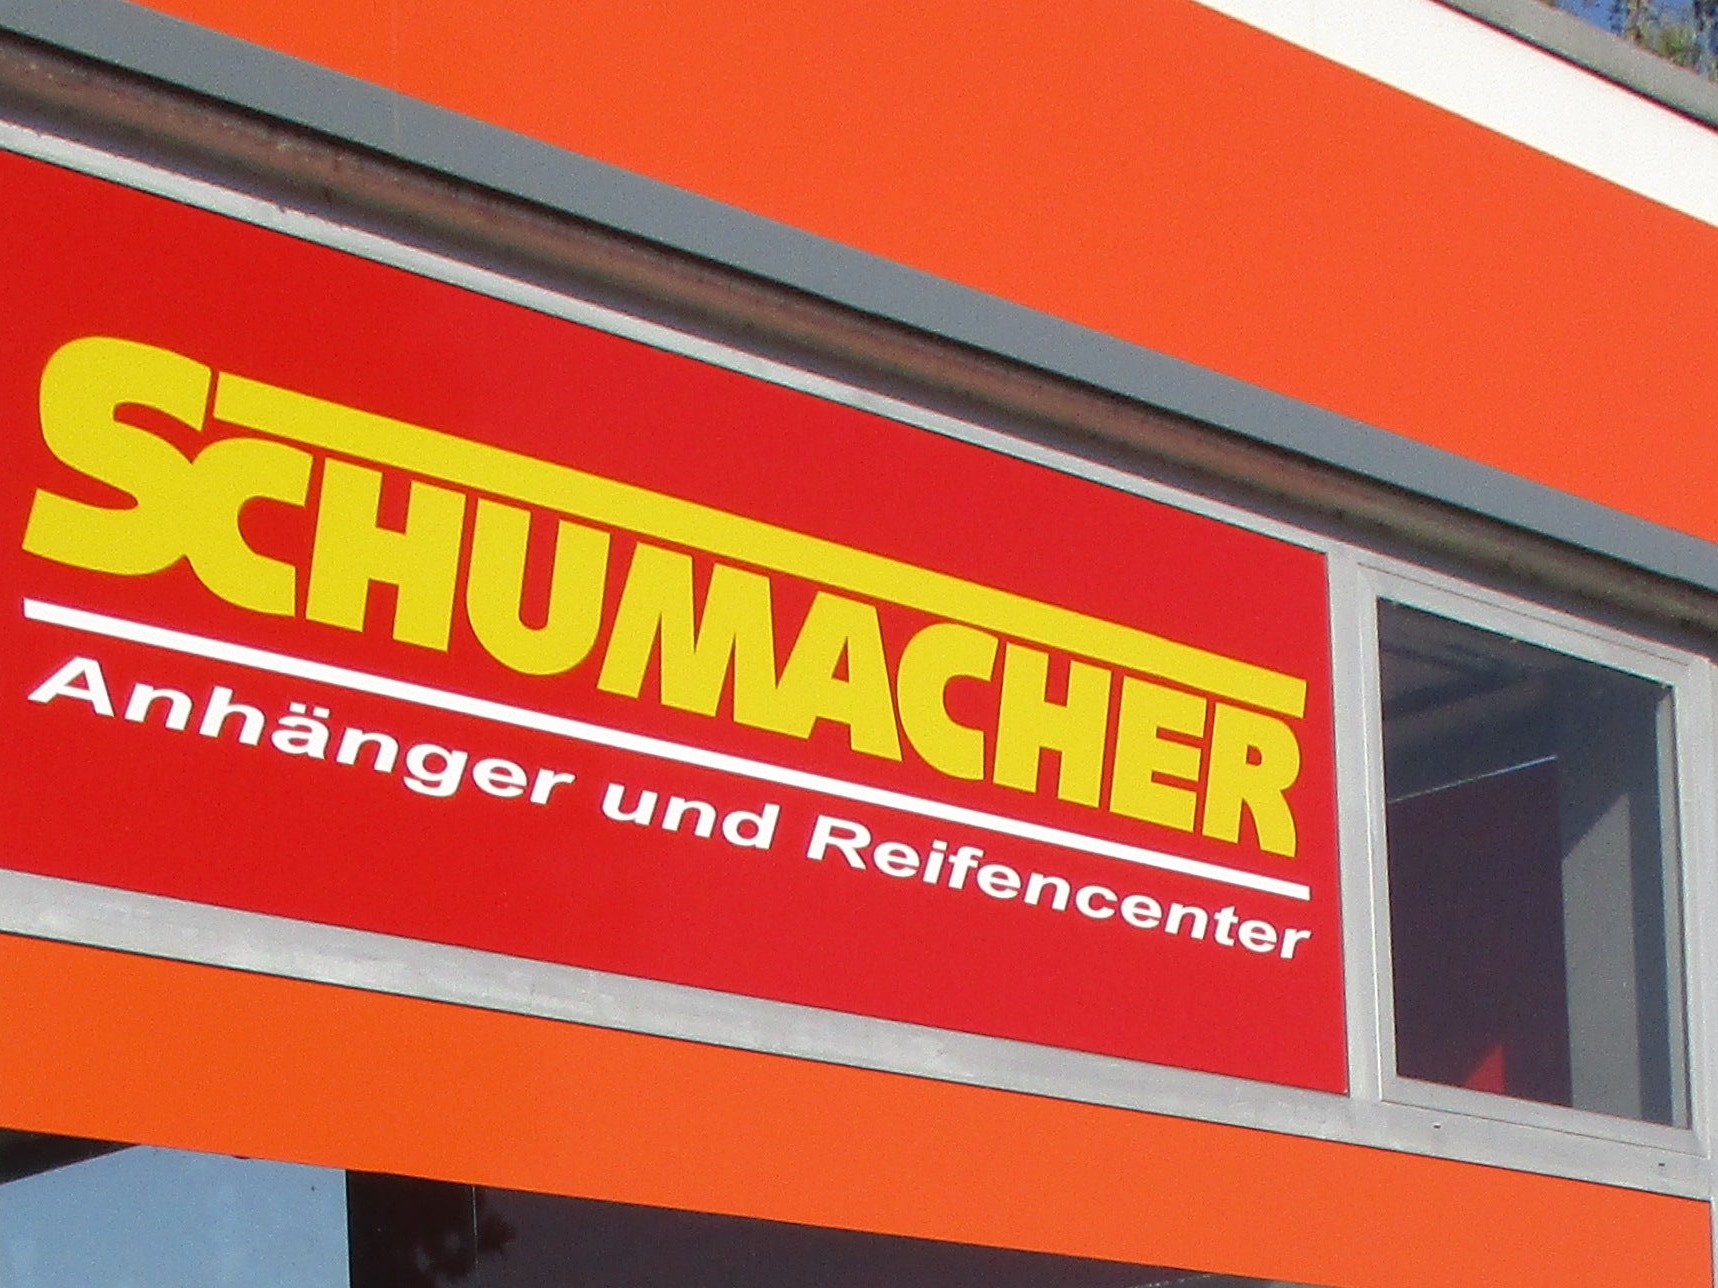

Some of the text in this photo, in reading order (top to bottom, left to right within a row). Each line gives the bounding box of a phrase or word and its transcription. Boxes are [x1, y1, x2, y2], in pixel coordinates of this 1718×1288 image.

[23, 336, 1302, 858] SCHUMACHER
[27, 656, 1312, 962] Anhänger und Reifencenter
